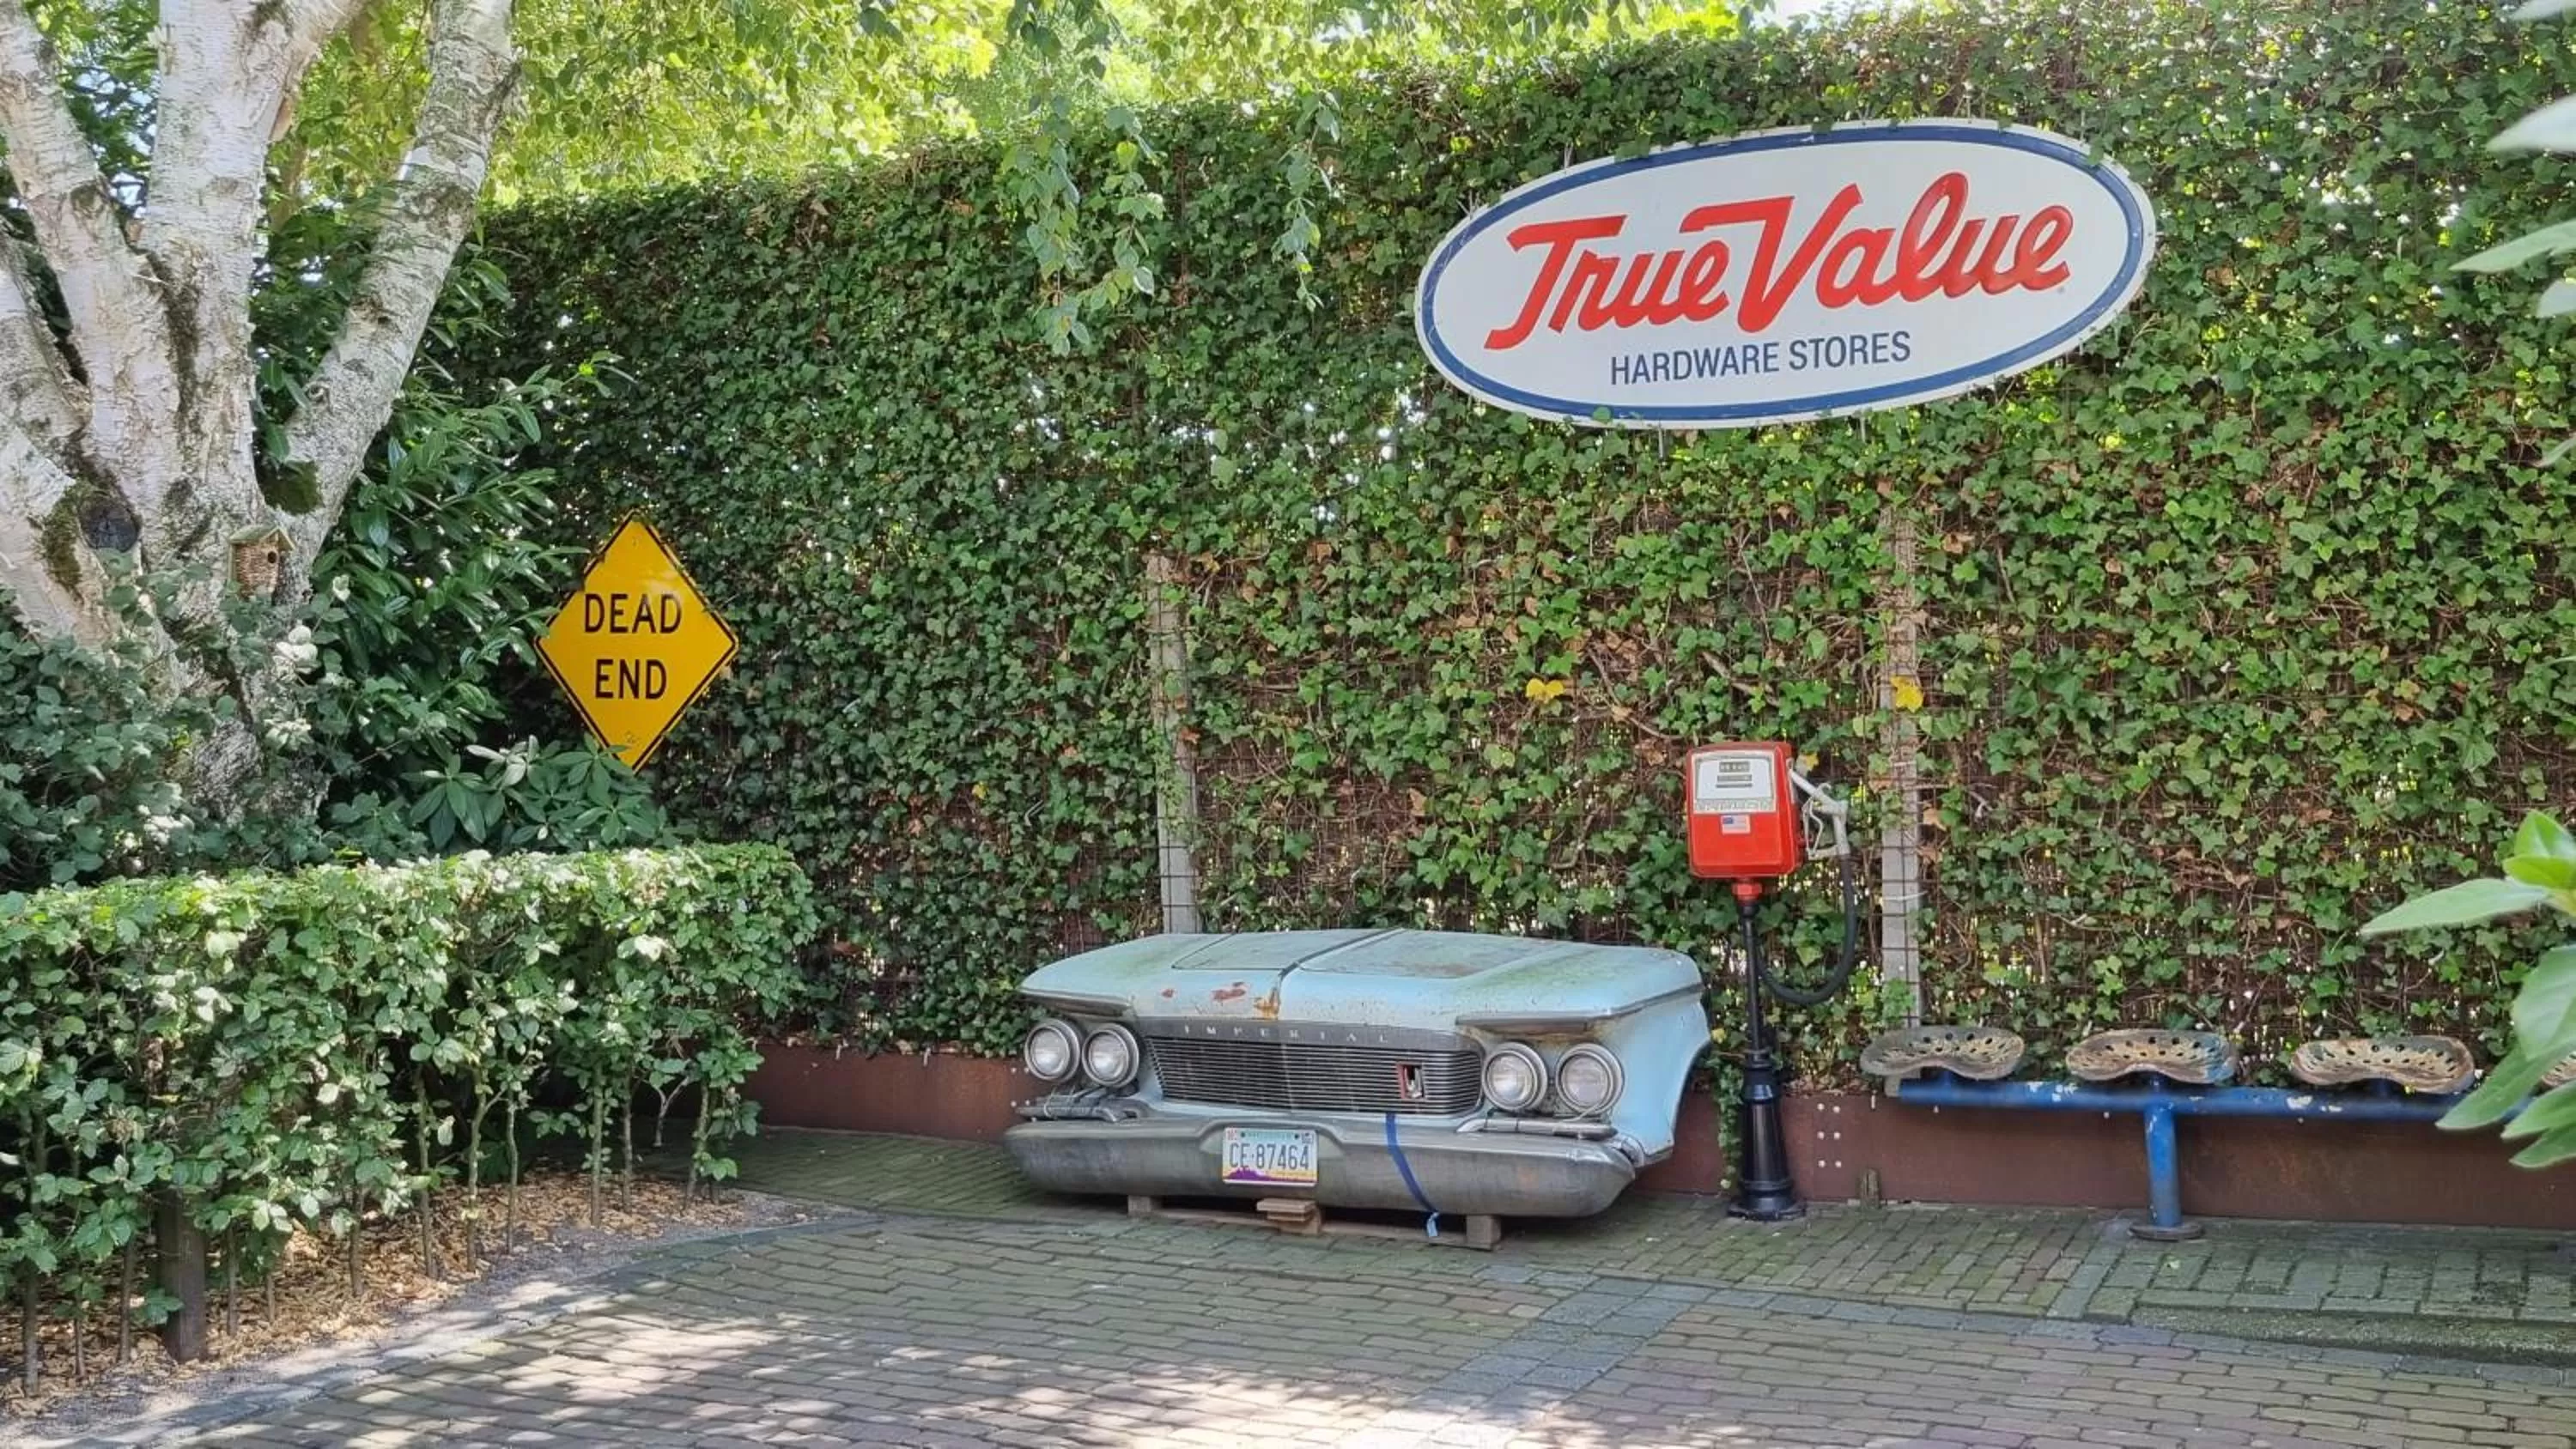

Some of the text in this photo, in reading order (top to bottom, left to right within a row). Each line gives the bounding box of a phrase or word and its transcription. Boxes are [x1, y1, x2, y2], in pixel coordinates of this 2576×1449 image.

[1610, 331, 1911, 386] HARDWARE STORES
[584, 593, 682, 634] DEAD
[595, 658, 667, 700] END
